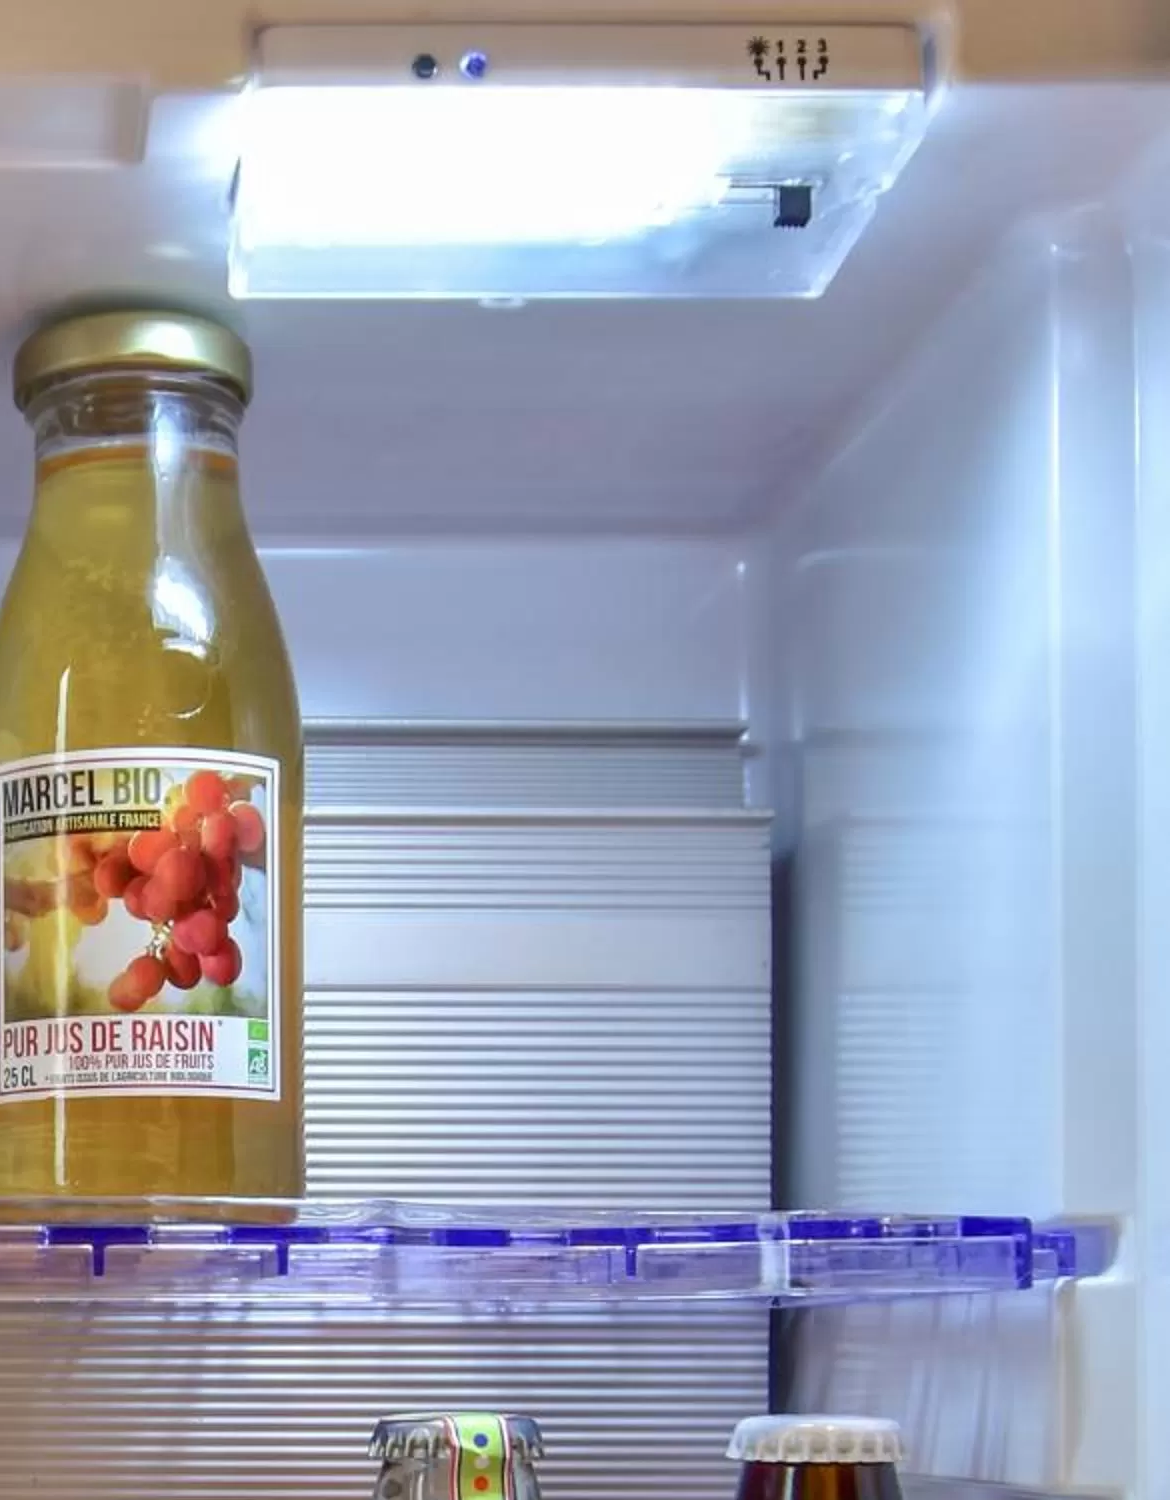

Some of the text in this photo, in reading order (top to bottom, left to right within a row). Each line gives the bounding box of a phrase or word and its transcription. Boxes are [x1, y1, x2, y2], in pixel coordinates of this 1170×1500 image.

[797, 39, 807, 53] 2
[818, 38, 828, 53] 3
[3, 769, 103, 818] MARCEL
[56, 812, 117, 834] ARTISANALE
[119, 810, 161, 829] FRANCE
[3, 1025, 38, 1059] PUR
[44, 1021, 84, 1055] JUS
[91, 1020, 123, 1053] DE
[105, 1054, 129, 1070] PUR
[131, 1053, 153, 1069] JUS
[155, 1053, 171, 1069] DE
[174, 1053, 215, 1070] FRUITS
[3, 1067, 18, 1089] 25
[21, 1065, 37, 1087] CL
